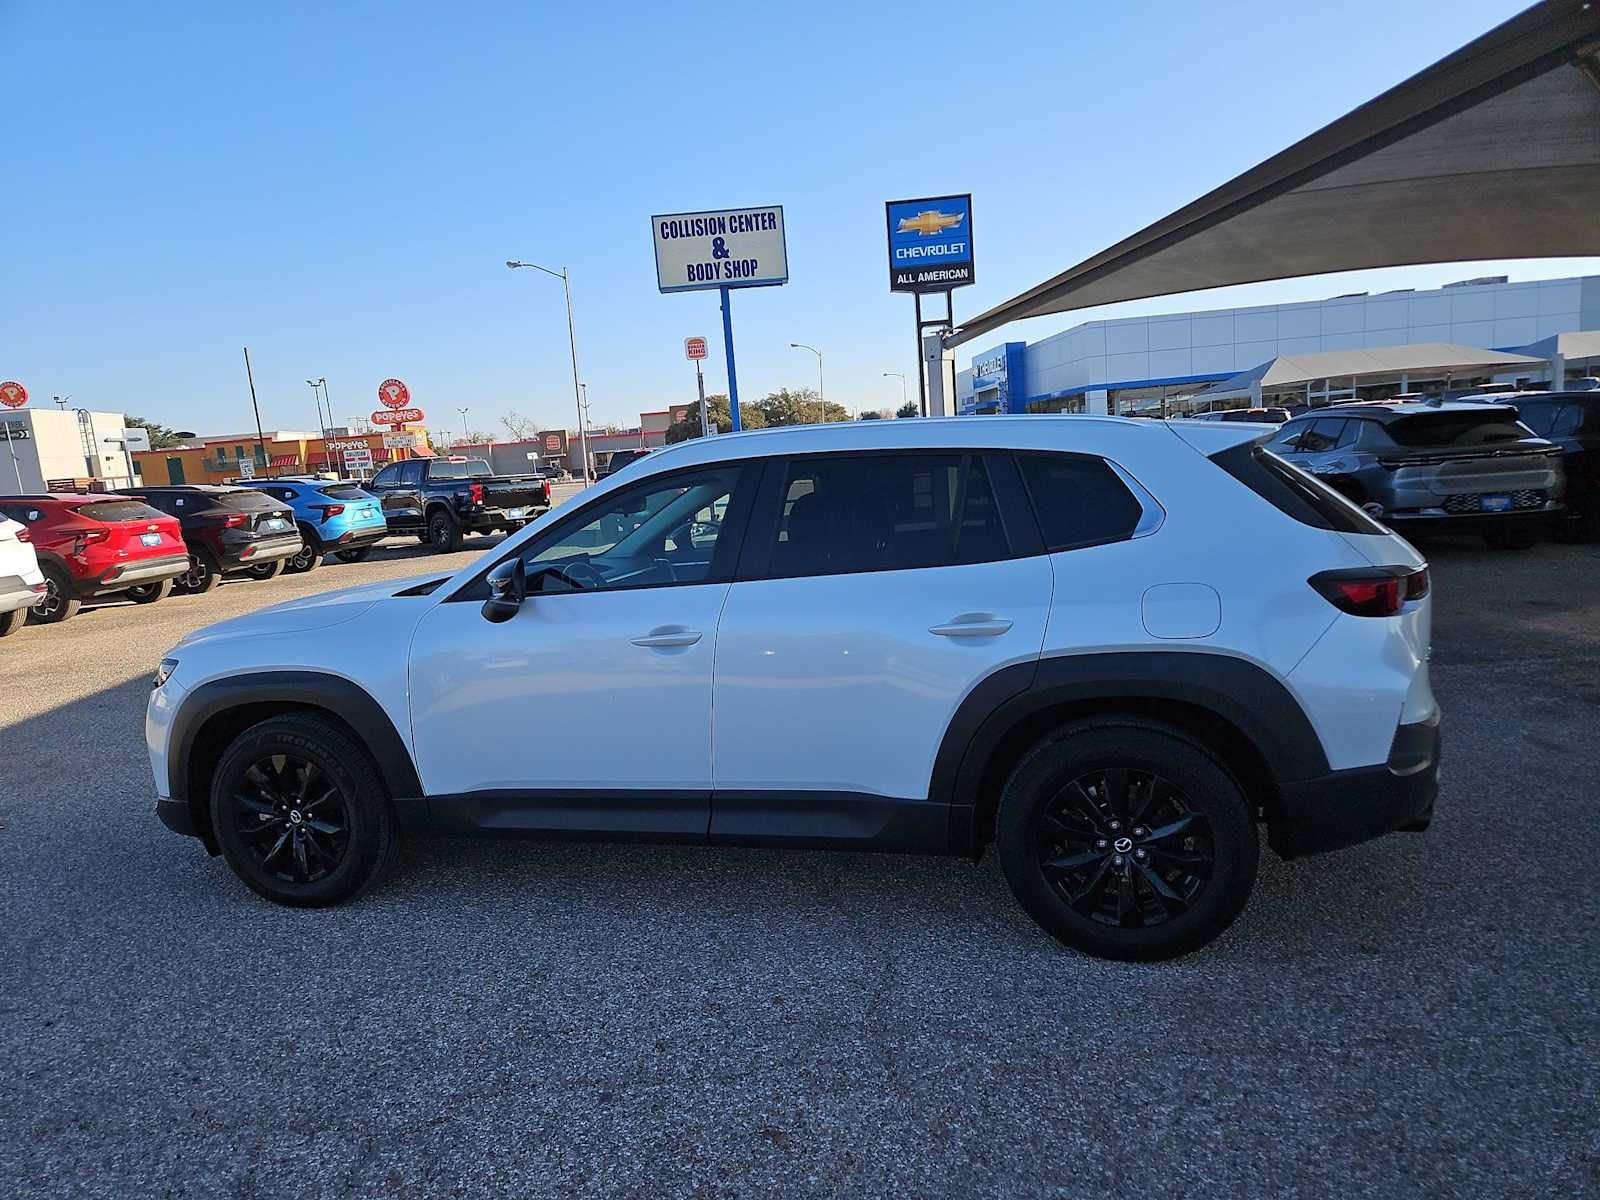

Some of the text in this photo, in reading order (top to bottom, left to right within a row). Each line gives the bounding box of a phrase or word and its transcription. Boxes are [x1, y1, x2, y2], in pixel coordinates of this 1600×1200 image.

[661, 212, 777, 240] COLLISION CENTER
[712, 237, 729, 260] &
[896, 243, 966, 259] CHEVROLET
[687, 259, 758, 282] BODY SHOP
[897, 268, 969, 284] ALL AMERICAN
[242, 468, 253, 476] 35
